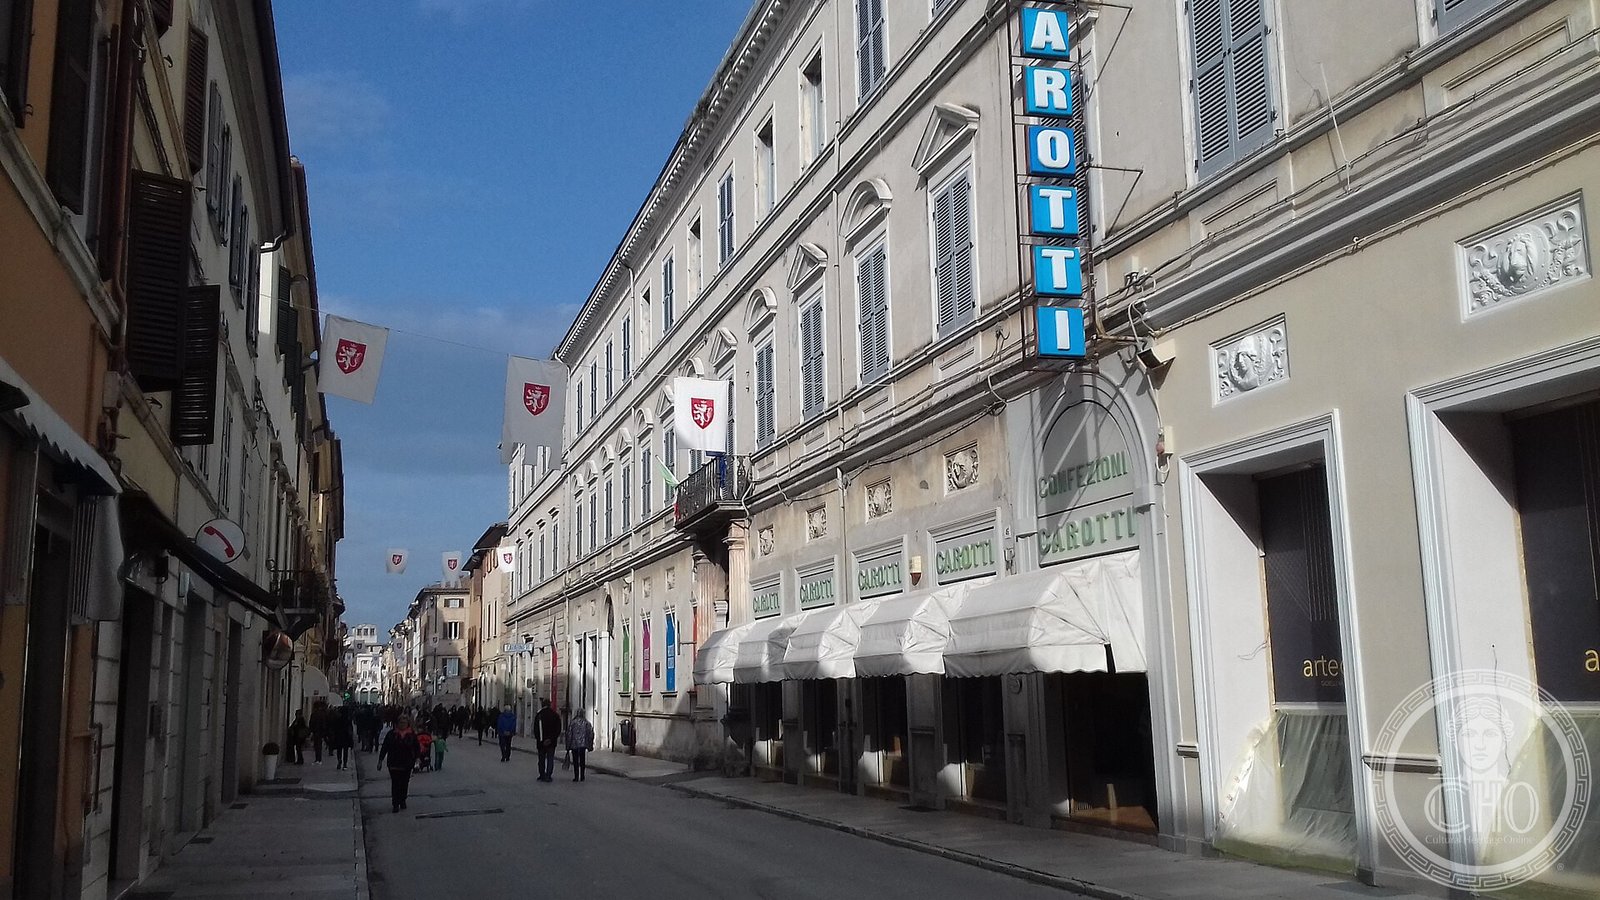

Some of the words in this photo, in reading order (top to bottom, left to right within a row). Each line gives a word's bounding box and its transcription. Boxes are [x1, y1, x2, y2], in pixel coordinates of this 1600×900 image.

[1030, 11, 1075, 350] AROTTI
[1039, 451, 1127, 499] CONFEZIONI
[1039, 506, 1135, 556] CAROTTI
[936, 539, 995, 575] CAROTTI
[800, 577, 834, 603] CAROTTI
[858, 562, 901, 591] CAROTTI
[753, 592, 780, 613] CAROTTI
